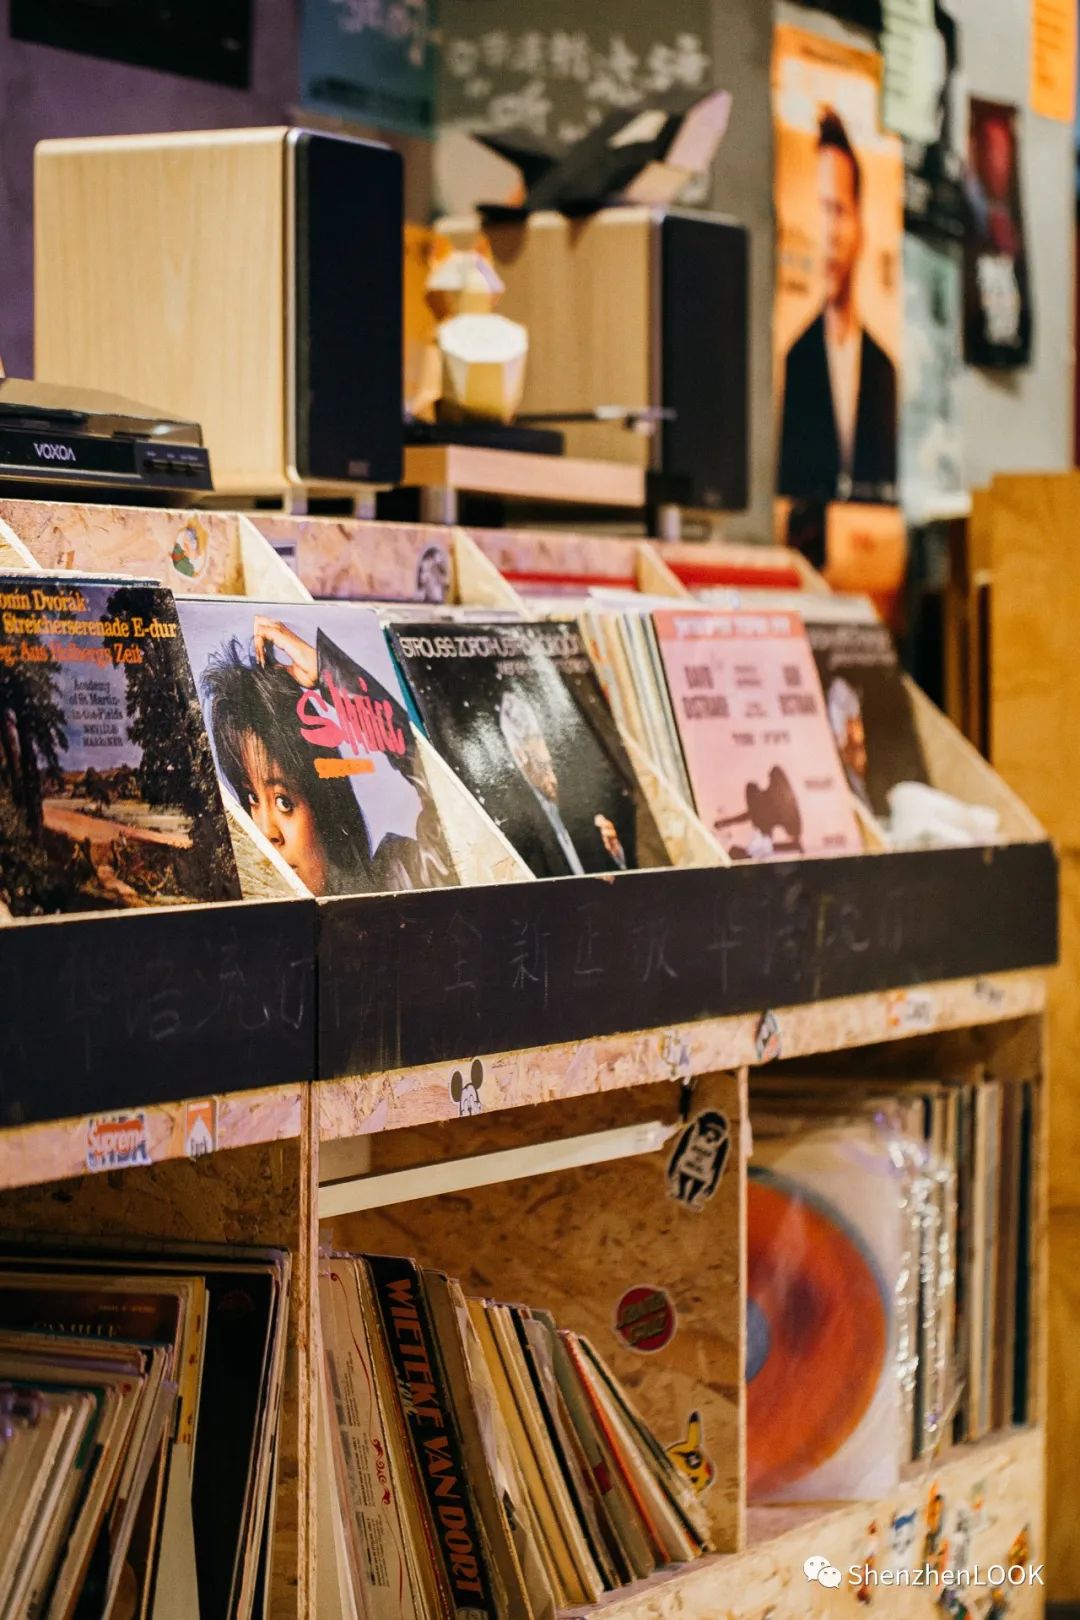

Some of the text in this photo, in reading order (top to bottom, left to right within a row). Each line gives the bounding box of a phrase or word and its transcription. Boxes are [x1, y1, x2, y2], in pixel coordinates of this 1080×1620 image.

[131, 617, 177, 638] E-dur
[422, 1435, 461, 1499] VAN
[438, 1505, 484, 1600] DORT
